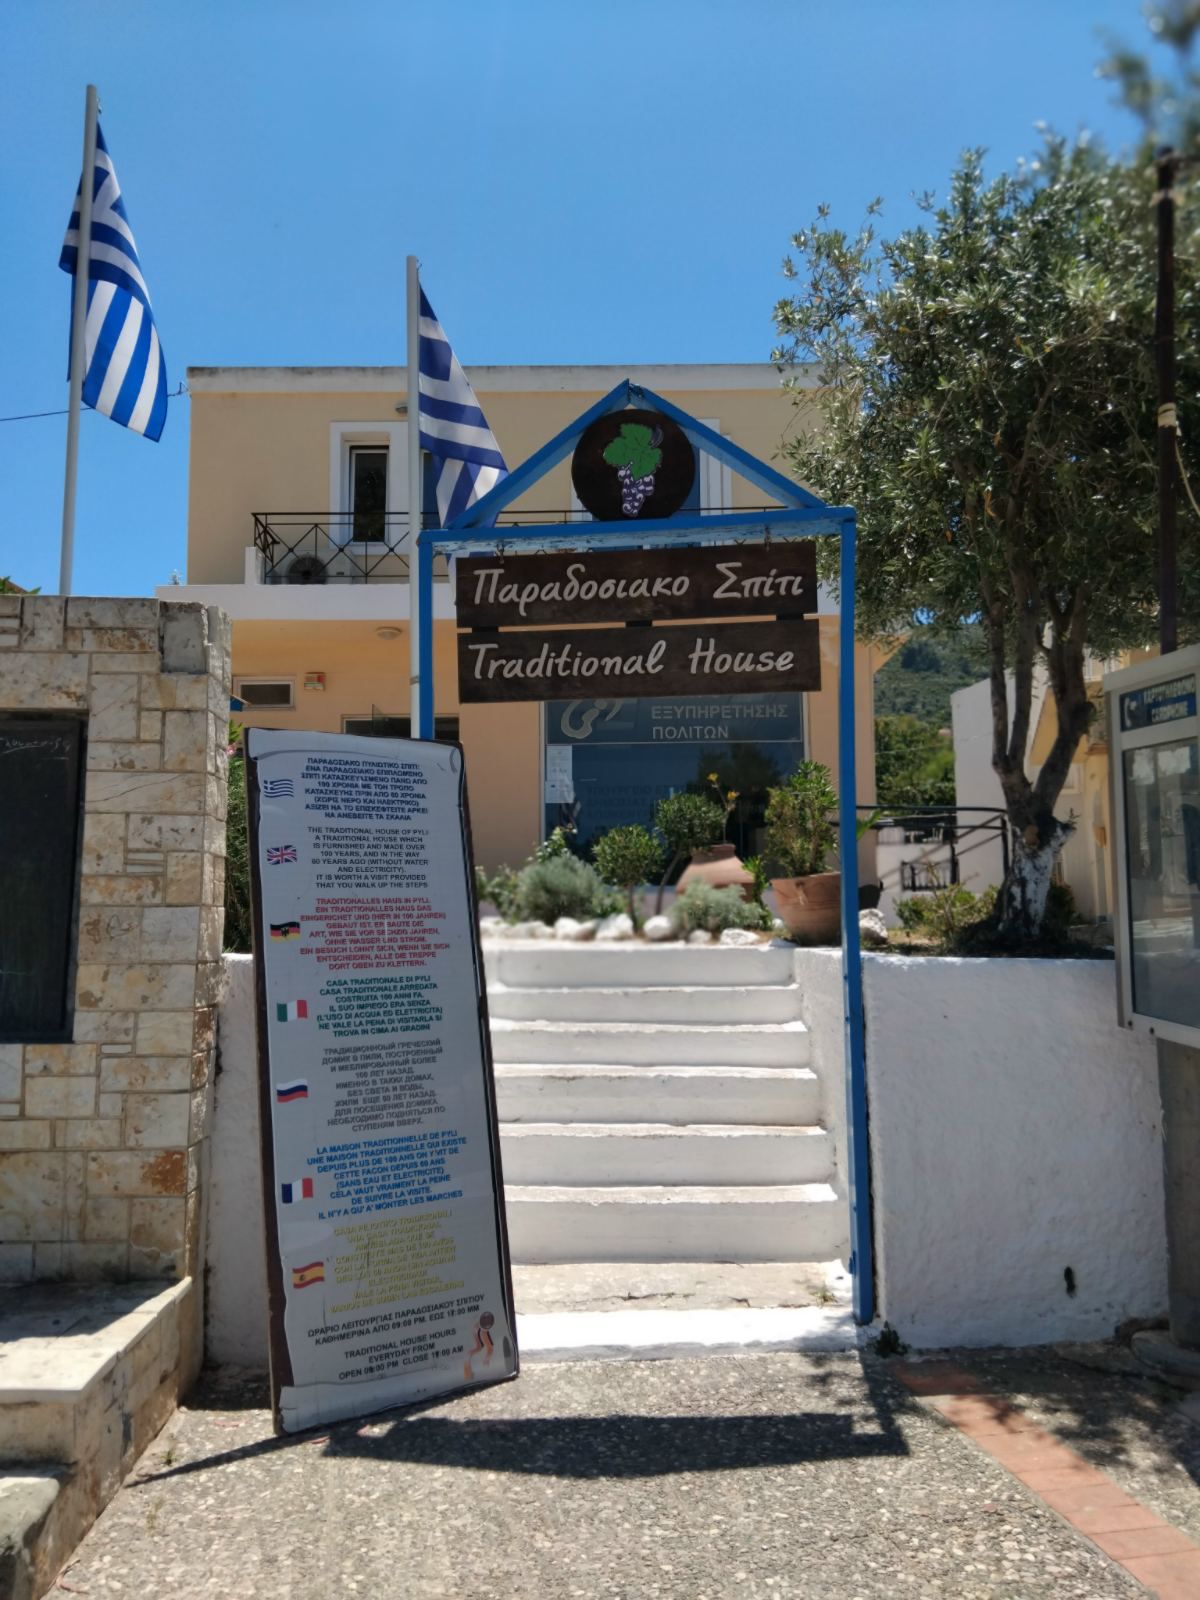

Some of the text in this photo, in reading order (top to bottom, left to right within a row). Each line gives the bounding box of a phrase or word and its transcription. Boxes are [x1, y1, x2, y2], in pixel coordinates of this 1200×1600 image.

[473, 561, 804, 616] Παραδοσιακο Σπίτι
[468, 637, 795, 680] Traditional House
[651, 703, 789, 720] ΕΞΥΠΗΡΕΤΗΣΗΣ
[652, 725, 729, 740] ΠΟΛΙΤΩΝ
[325, 826, 373, 835] TRADITIONAL
[368, 858, 402, 866] (WITHOUT
[319, 982, 437, 996] CASA TRADITIONALE ARREDATA
[326, 979, 349, 987] CASA
[351, 976, 404, 986] TRADITIONALE
[335, 994, 379, 1003] COSTRUITA
[357, 1002, 388, 1010] IMPIEGO
[407, 999, 430, 1007] SENZA
[331, 1021, 352, 1029] VALE
[365, 1018, 386, 1027] PENA
[397, 1015, 433, 1024] VISITARLA
[354, 1010, 381, 1019] ACQUA
[334, 1029, 359, 1037] TROVA
[370, 1026, 389, 1035] CIMA
[400, 1023, 430, 1032] GRADINI
[307, 1137, 467, 1165] UNE MAISON TRADITIONNELLE QUI EXISTE
[330, 1142, 361, 1153] MAISON
[363, 1133, 428, 1149] TRADITIONNELLE
[317, 1162, 347, 1173] DEPUIS
[349, 1159, 369, 1169] PLUS
[399, 1153, 414, 1162] ANS
[334, 1158, 445, 1180] CETTE DEPUIS ANS
[330, 1189, 352, 1199] CELA
[354, 1186, 374, 1196] VAUT
[376, 1179, 416, 1192] VRAIMENT
[429, 1174, 450, 1184] PEINE
[363, 1176, 379, 1185] EAU
[365, 1192, 393, 1203] SUIVRE
[375, 1199, 408, 1211] MONTER
[410, 1196, 424, 1205] LES
[426, 1190, 463, 1202] MARCHES
[308, 1324, 339, 1337] ΩΡΑΡΙΟ
[342, 1313, 392, 1330] ΛΕΙΤΟΥΡΓΙΑΣ
[373, 1323, 390, 1333] ΑΠΟ
[429, 1312, 444, 1322] ΕΩΣ
[344, 1328, 456, 1359] TRADITIONAL HOUSE HOURS
[369, 1342, 435, 1363] EVERYDAY FROM
[339, 1368, 362, 1380] OPEN
[403, 1353, 428, 1365] CLOSE
